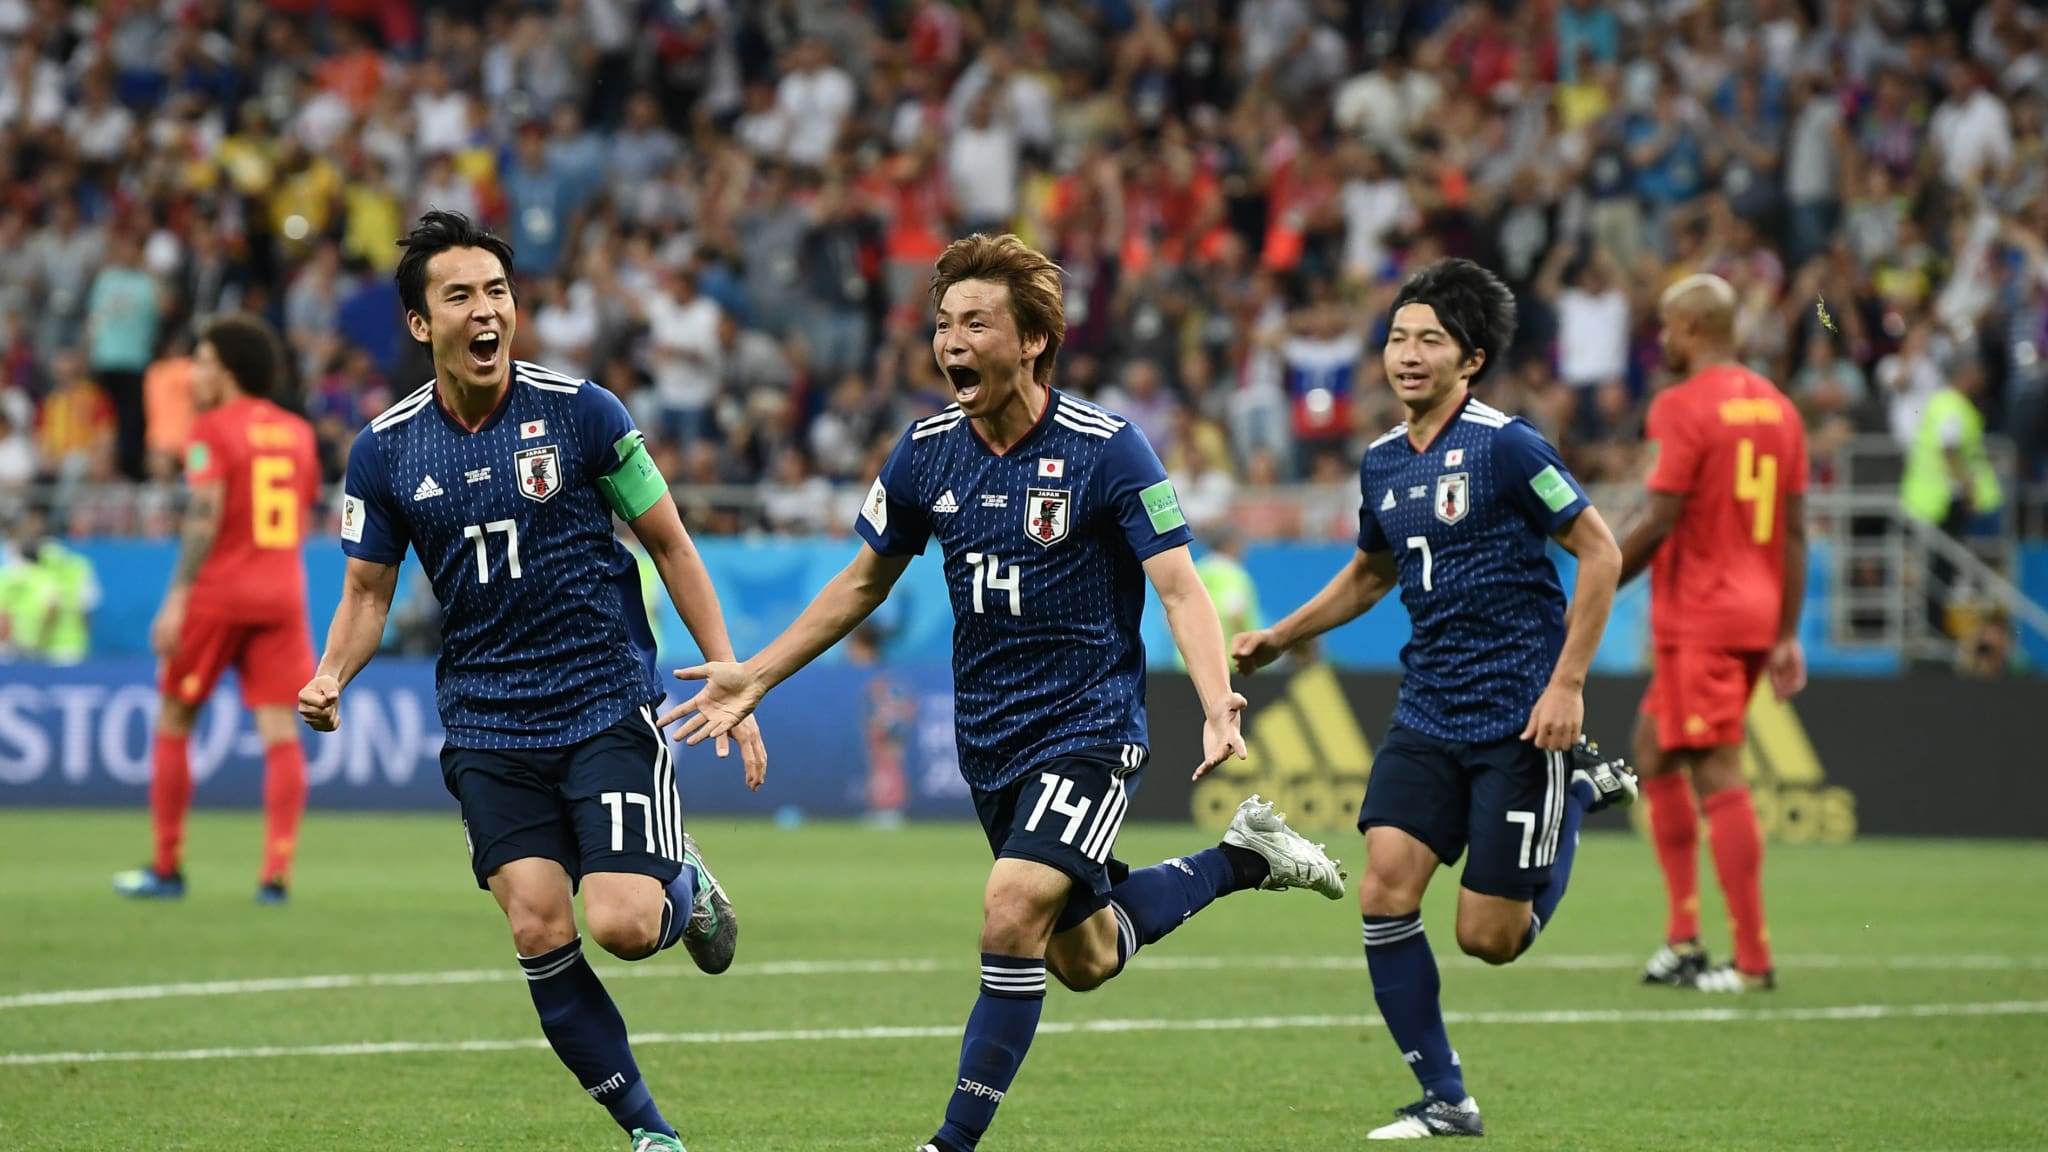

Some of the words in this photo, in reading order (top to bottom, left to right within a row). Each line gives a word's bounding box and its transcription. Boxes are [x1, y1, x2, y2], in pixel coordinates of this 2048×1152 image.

[525, 449, 547, 457] JAPAN
[252, 456, 299, 550] 6
[1733, 438, 1777, 545] 4
[464, 518, 522, 584] 17
[1407, 536, 1432, 592] 7
[966, 552, 1021, 616] 14
[601, 791, 656, 854] 17
[1024, 772, 1091, 845] 14
[1506, 811, 1536, 869] 7
